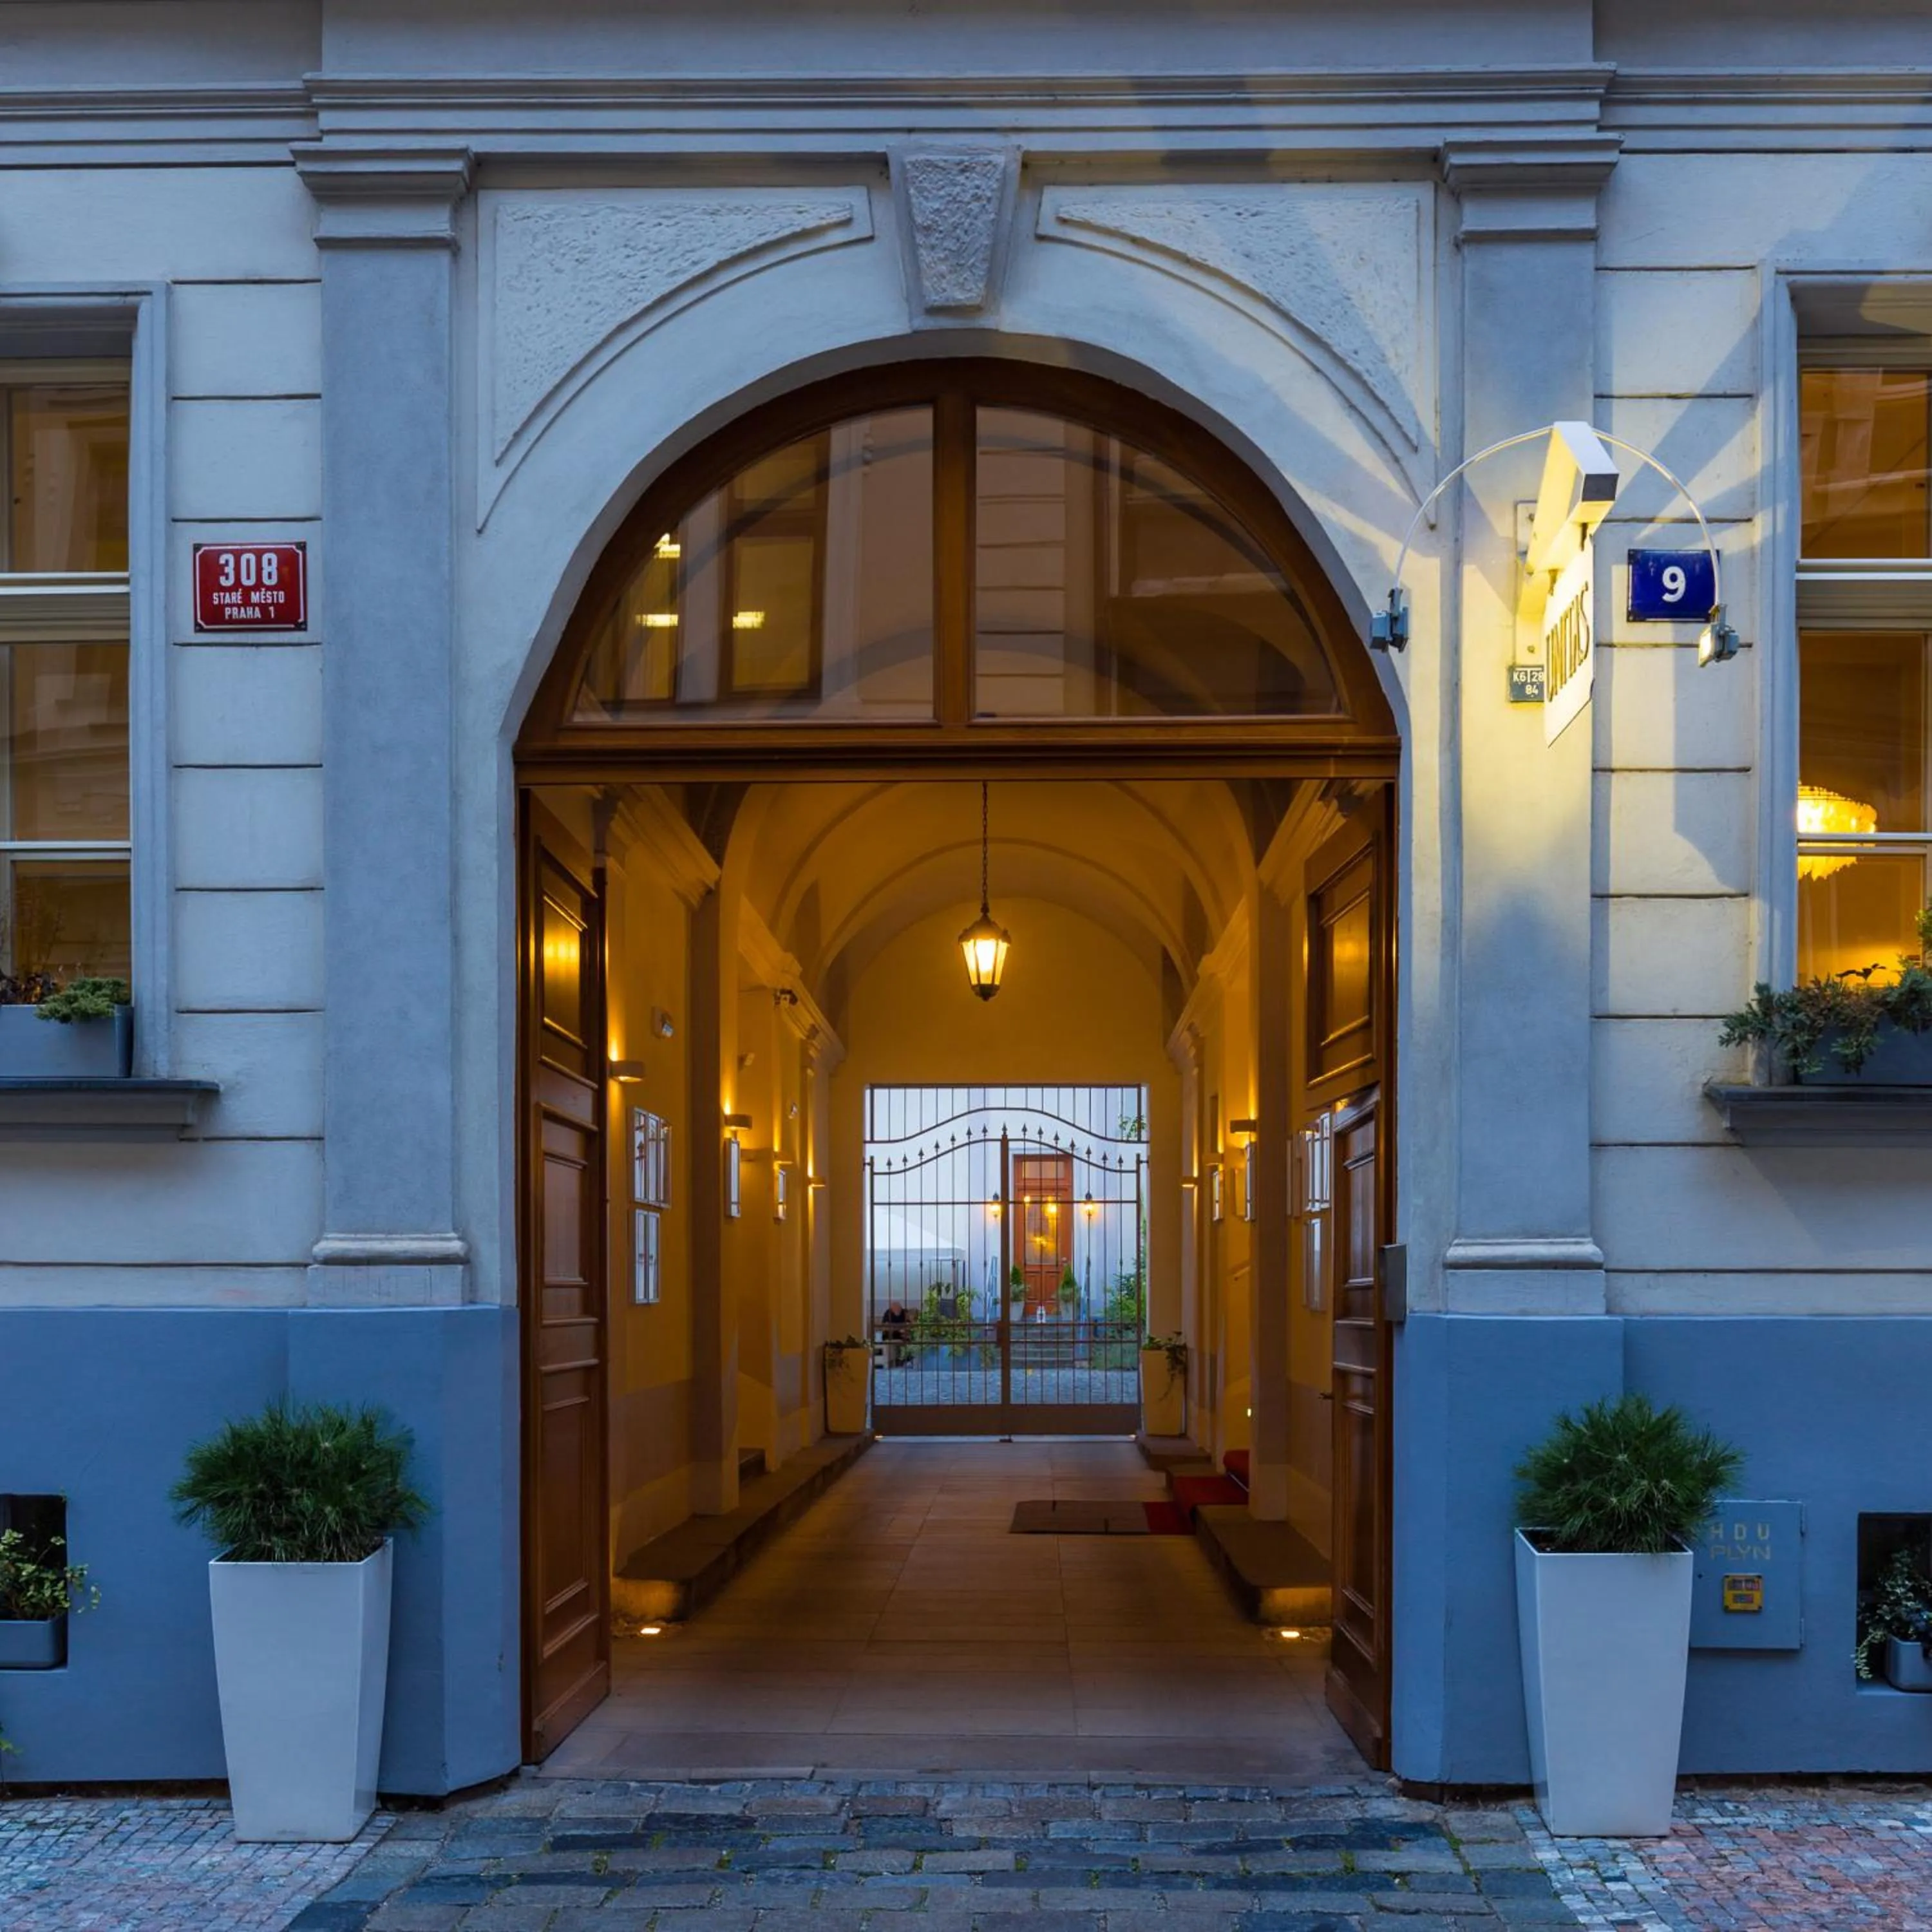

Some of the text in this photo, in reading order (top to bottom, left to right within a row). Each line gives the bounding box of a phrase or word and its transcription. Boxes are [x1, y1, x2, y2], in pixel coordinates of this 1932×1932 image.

[218, 552, 278, 587] 308
[1662, 565, 1687, 603] 9
[213, 587, 285, 605] STARÉ MĚSTO
[225, 606, 275, 620] PRAHA 1
[1709, 1544, 1771, 1560] PLYN
